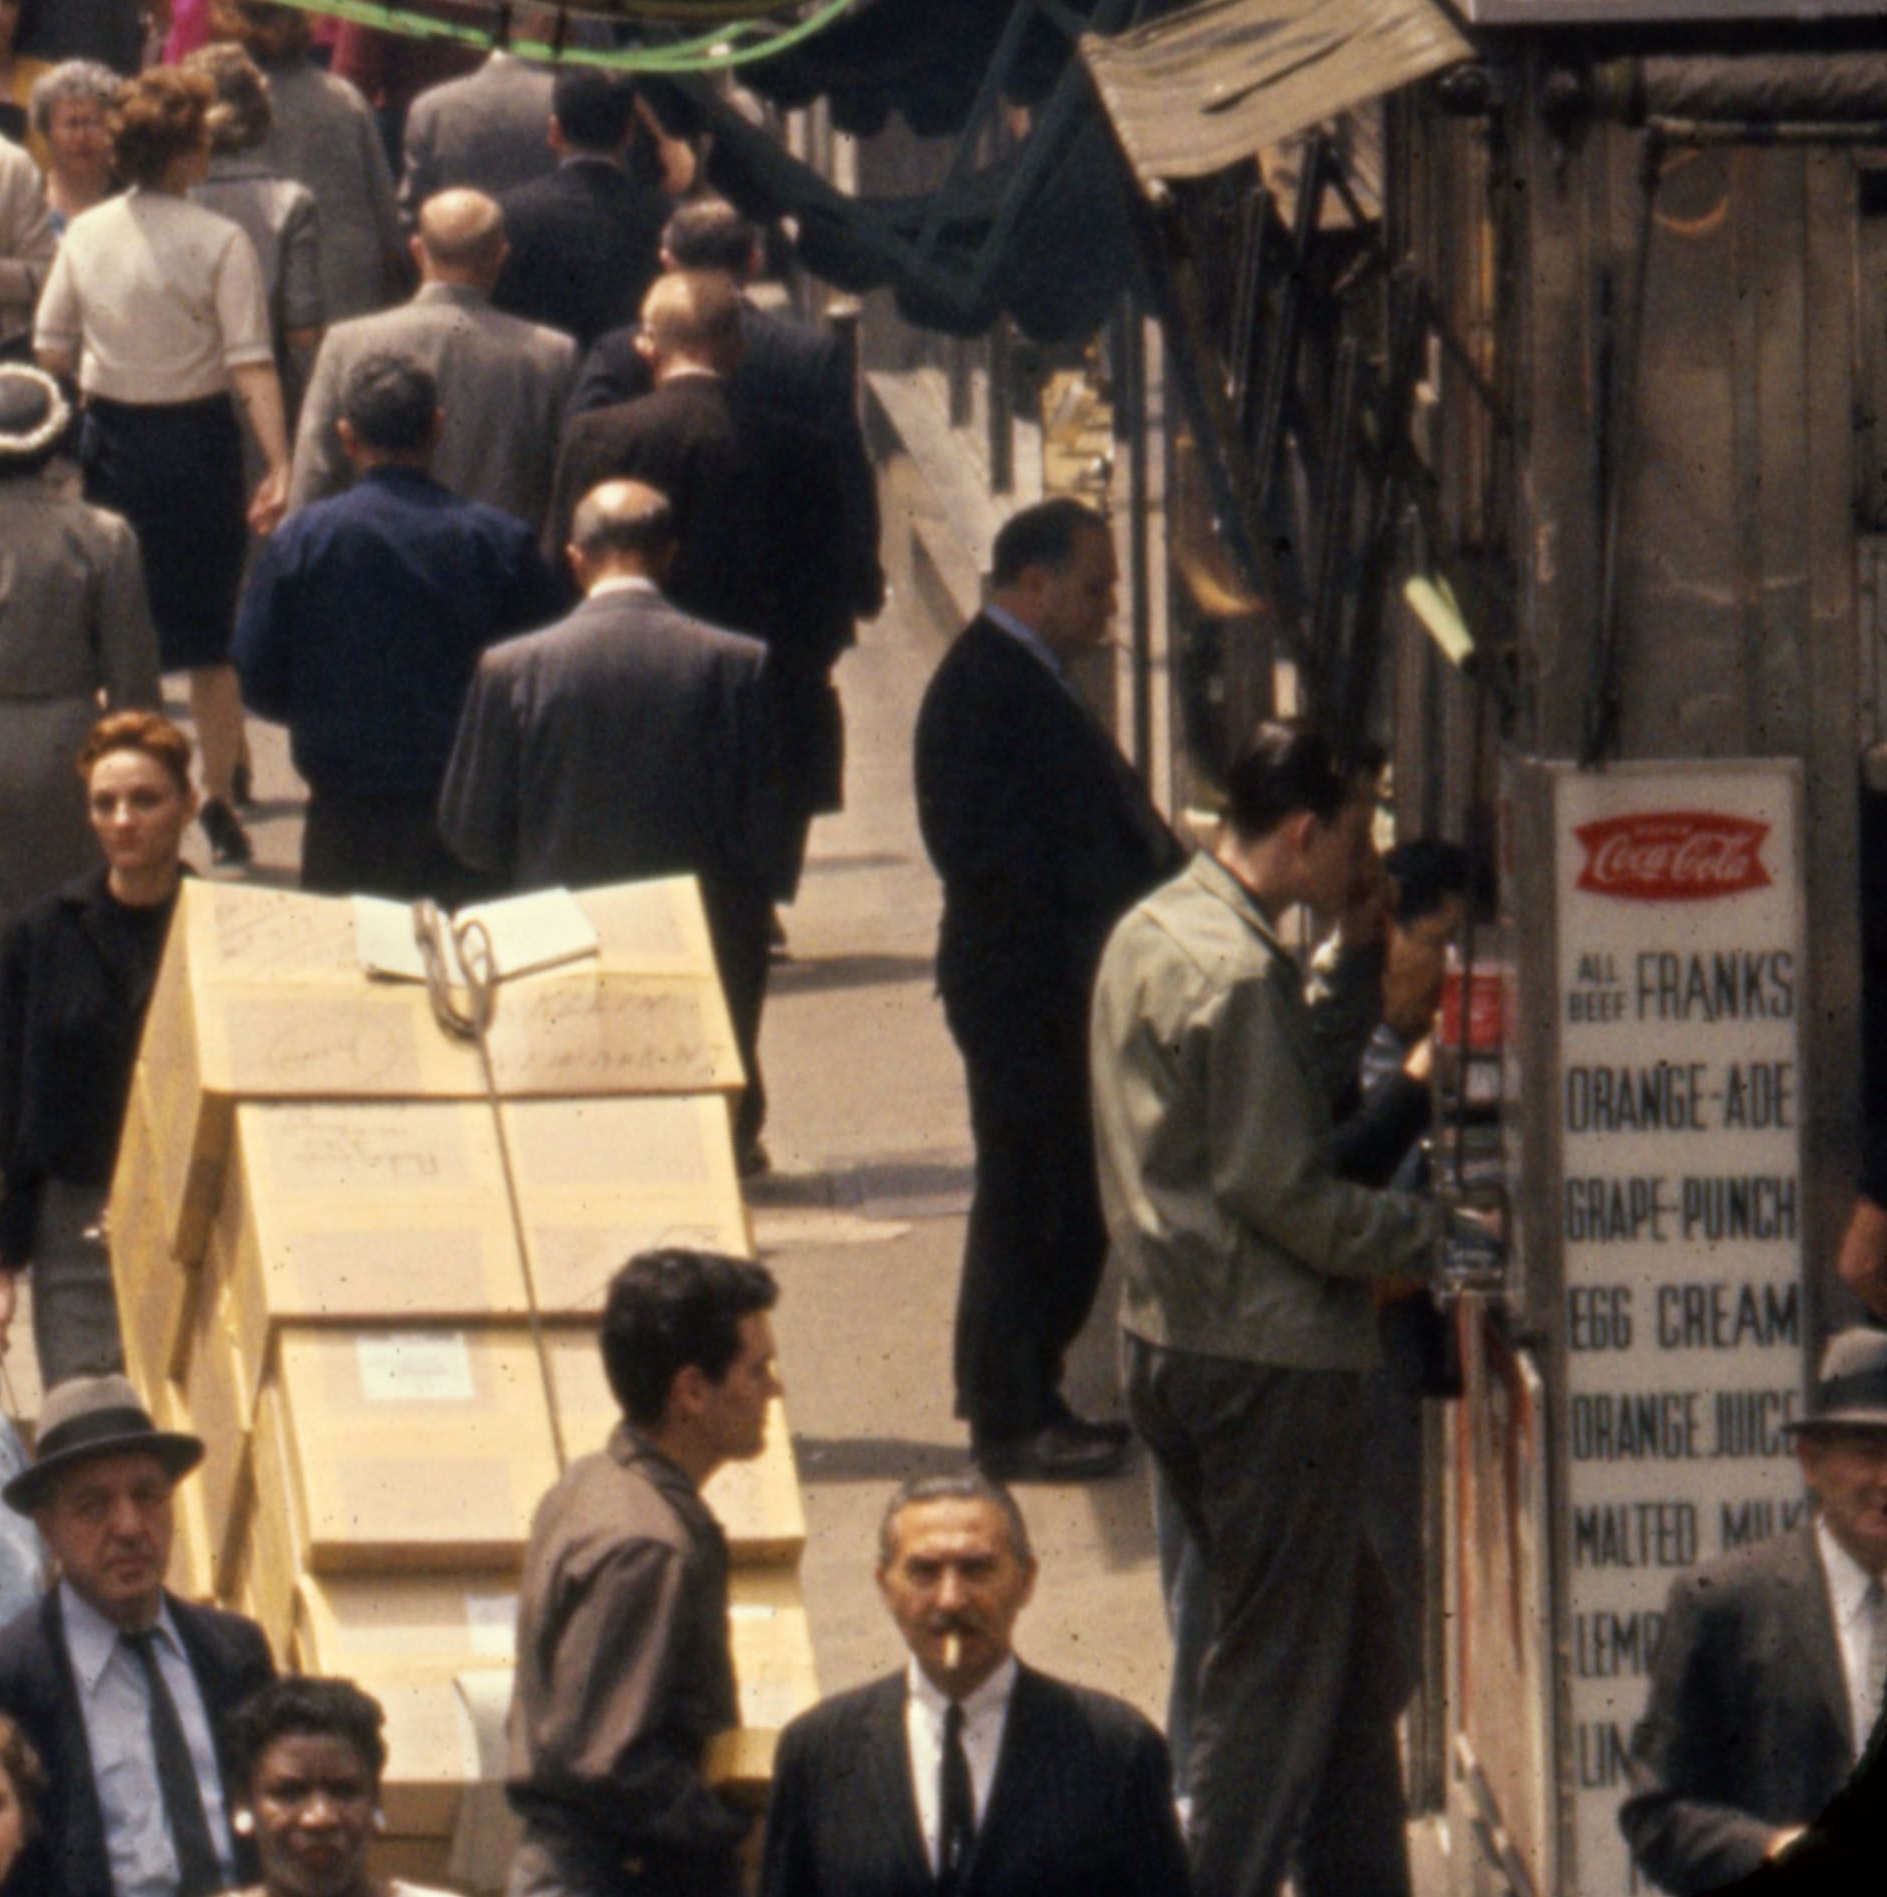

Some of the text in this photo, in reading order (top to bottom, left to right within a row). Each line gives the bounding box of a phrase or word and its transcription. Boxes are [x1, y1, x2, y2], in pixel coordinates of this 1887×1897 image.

[1578, 953, 1618, 985] ALL
[1635, 950, 1794, 1023] FRANKS
[1569, 991, 1625, 1023] BEEF
[1567, 1060, 1794, 1132] ORANGE-ADE
[1565, 1175, 1799, 1242] GRAPE-PUNCH
[1570, 1281, 1800, 1351] EGG CREAM
[1572, 1388, 1799, 1462] ORANGE JUICE
[1575, 1501, 1696, 1568] MALTED
